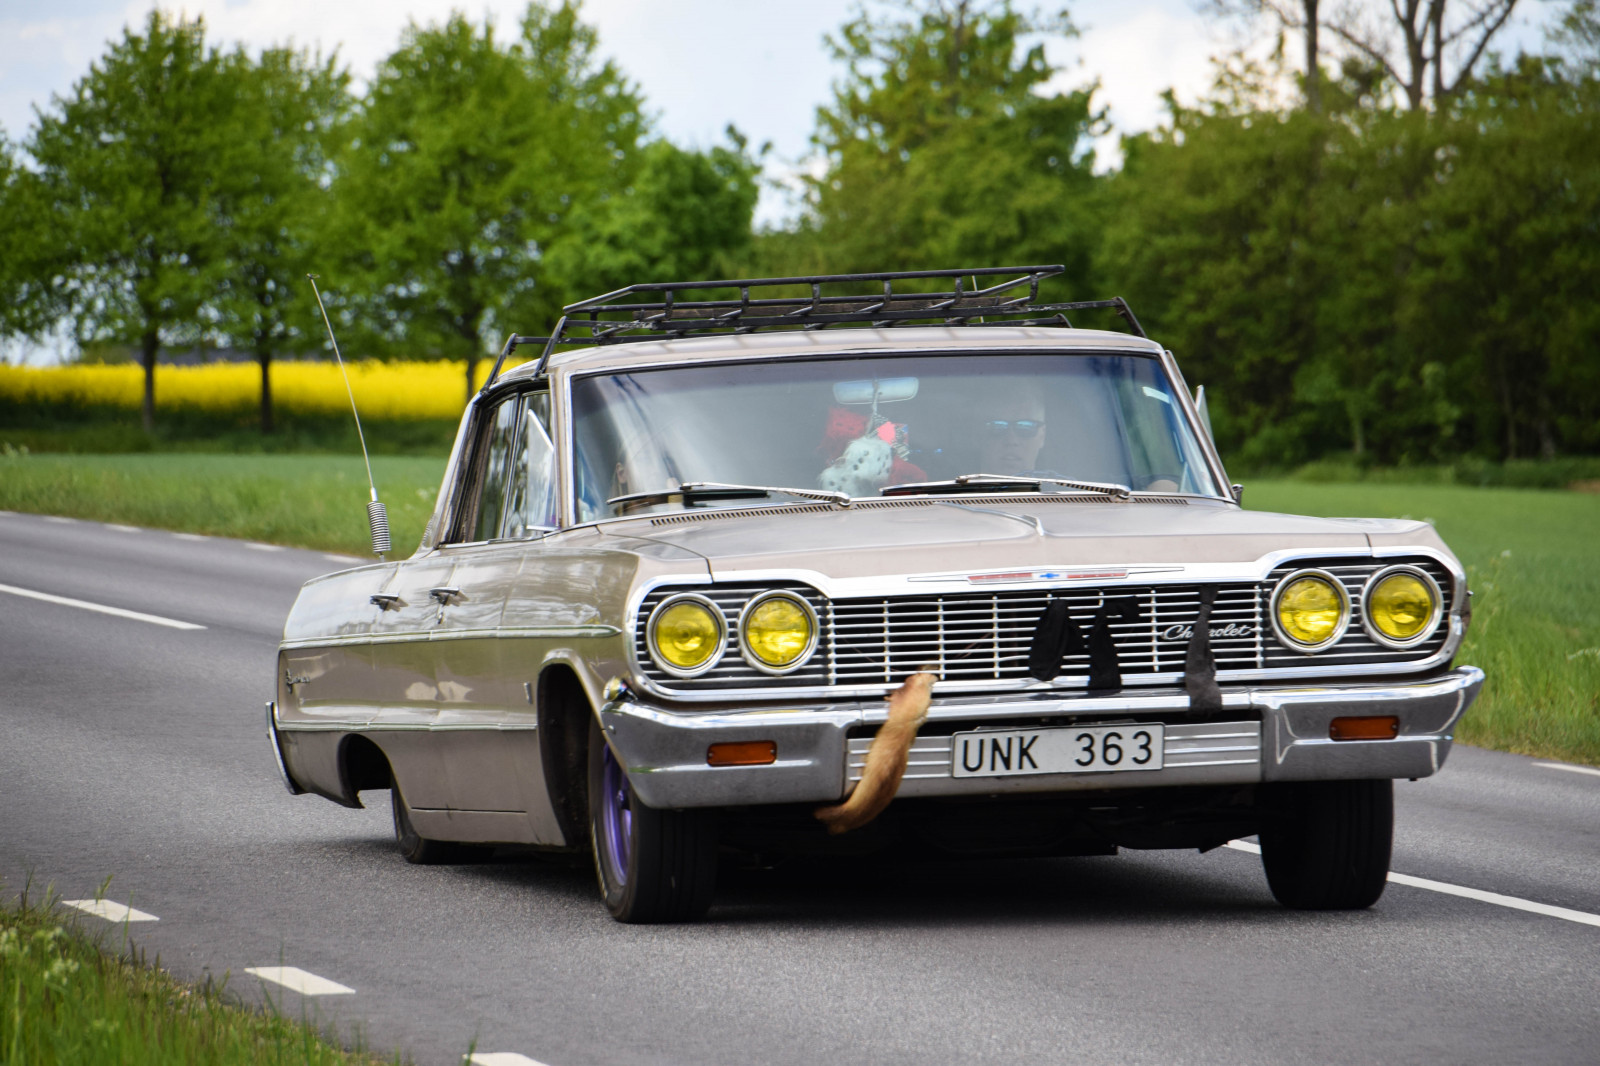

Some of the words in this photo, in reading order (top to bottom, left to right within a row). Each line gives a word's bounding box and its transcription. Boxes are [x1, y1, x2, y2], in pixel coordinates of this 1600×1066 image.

[1163, 623, 1252, 641] Chrolet
[963, 735, 1040, 772] UNK
[1074, 730, 1152, 767] 363
